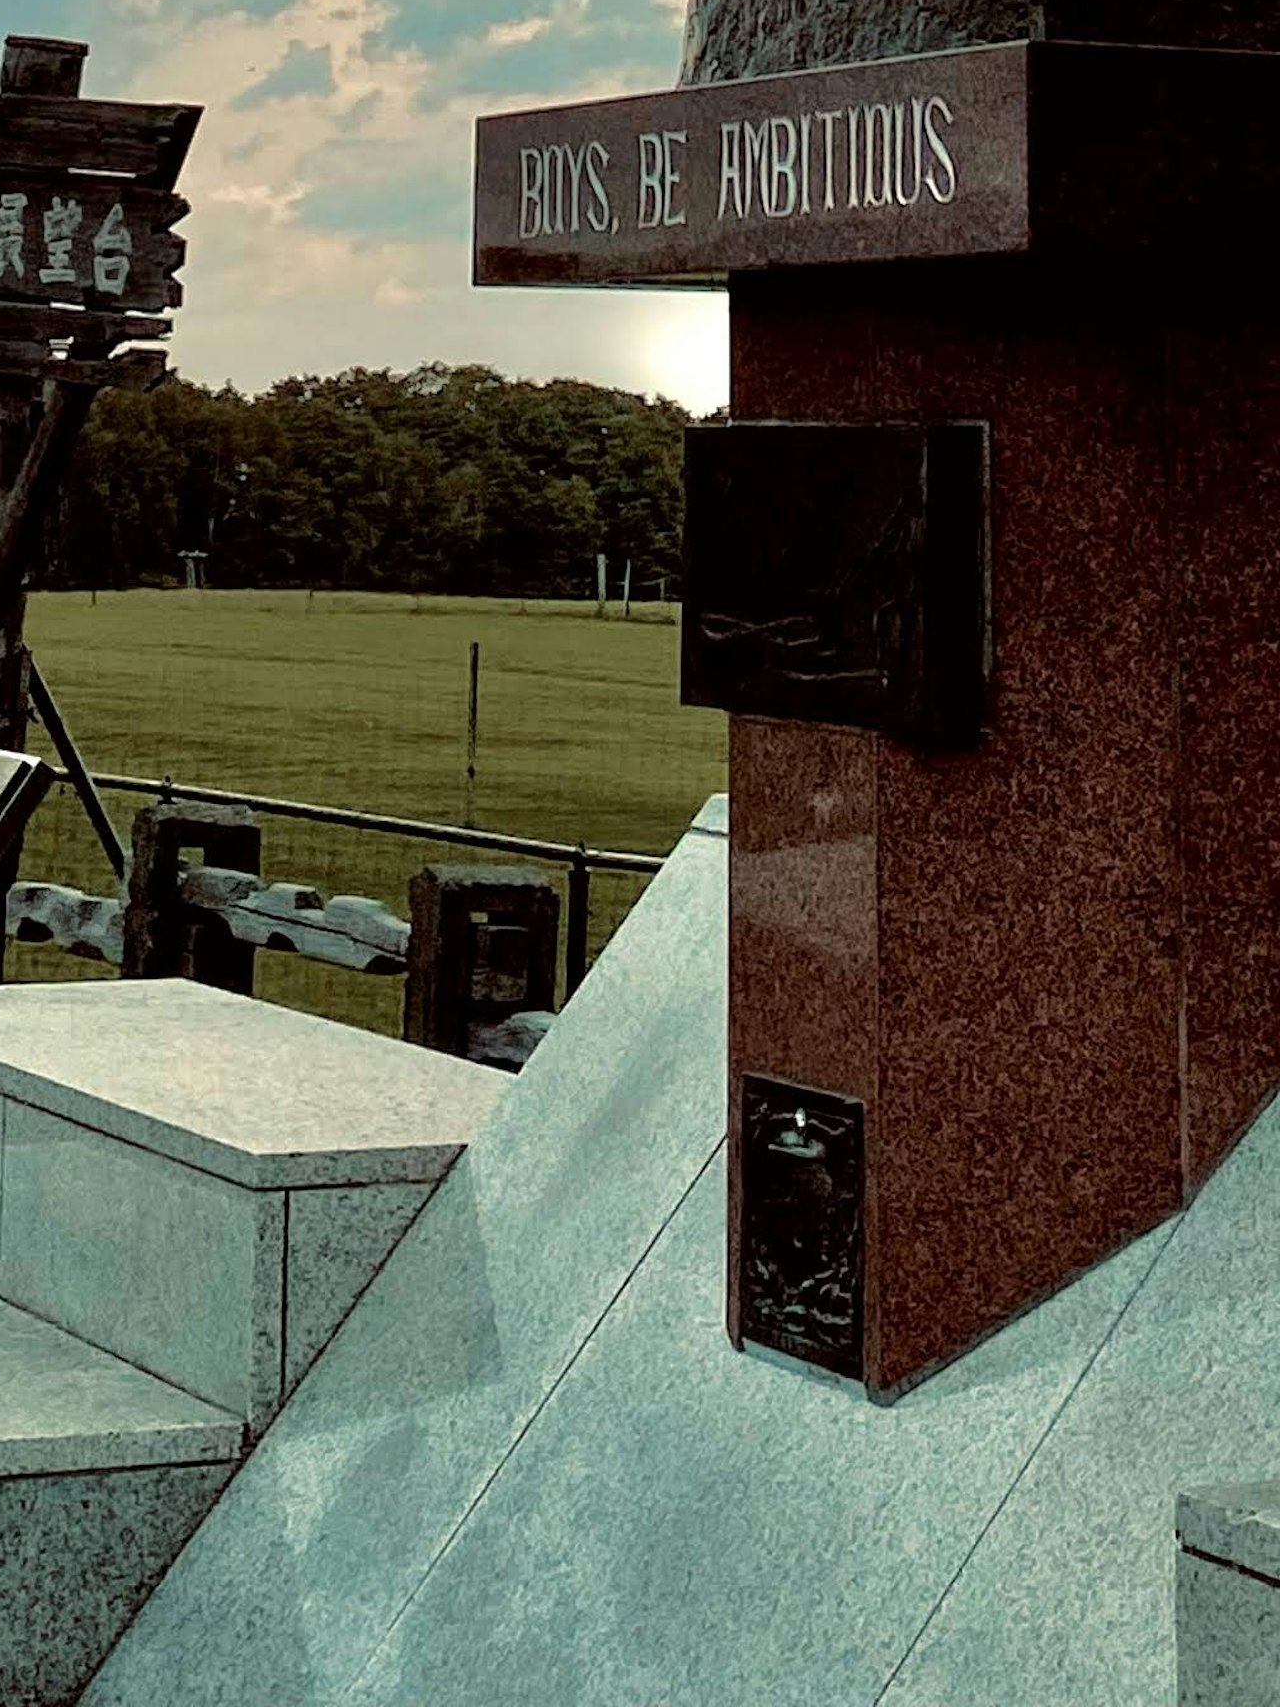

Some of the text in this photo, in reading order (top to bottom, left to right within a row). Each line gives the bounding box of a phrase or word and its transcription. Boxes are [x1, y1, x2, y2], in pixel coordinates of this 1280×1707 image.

[519, 95, 957, 239] BOYS, BE AMBITIOUS
